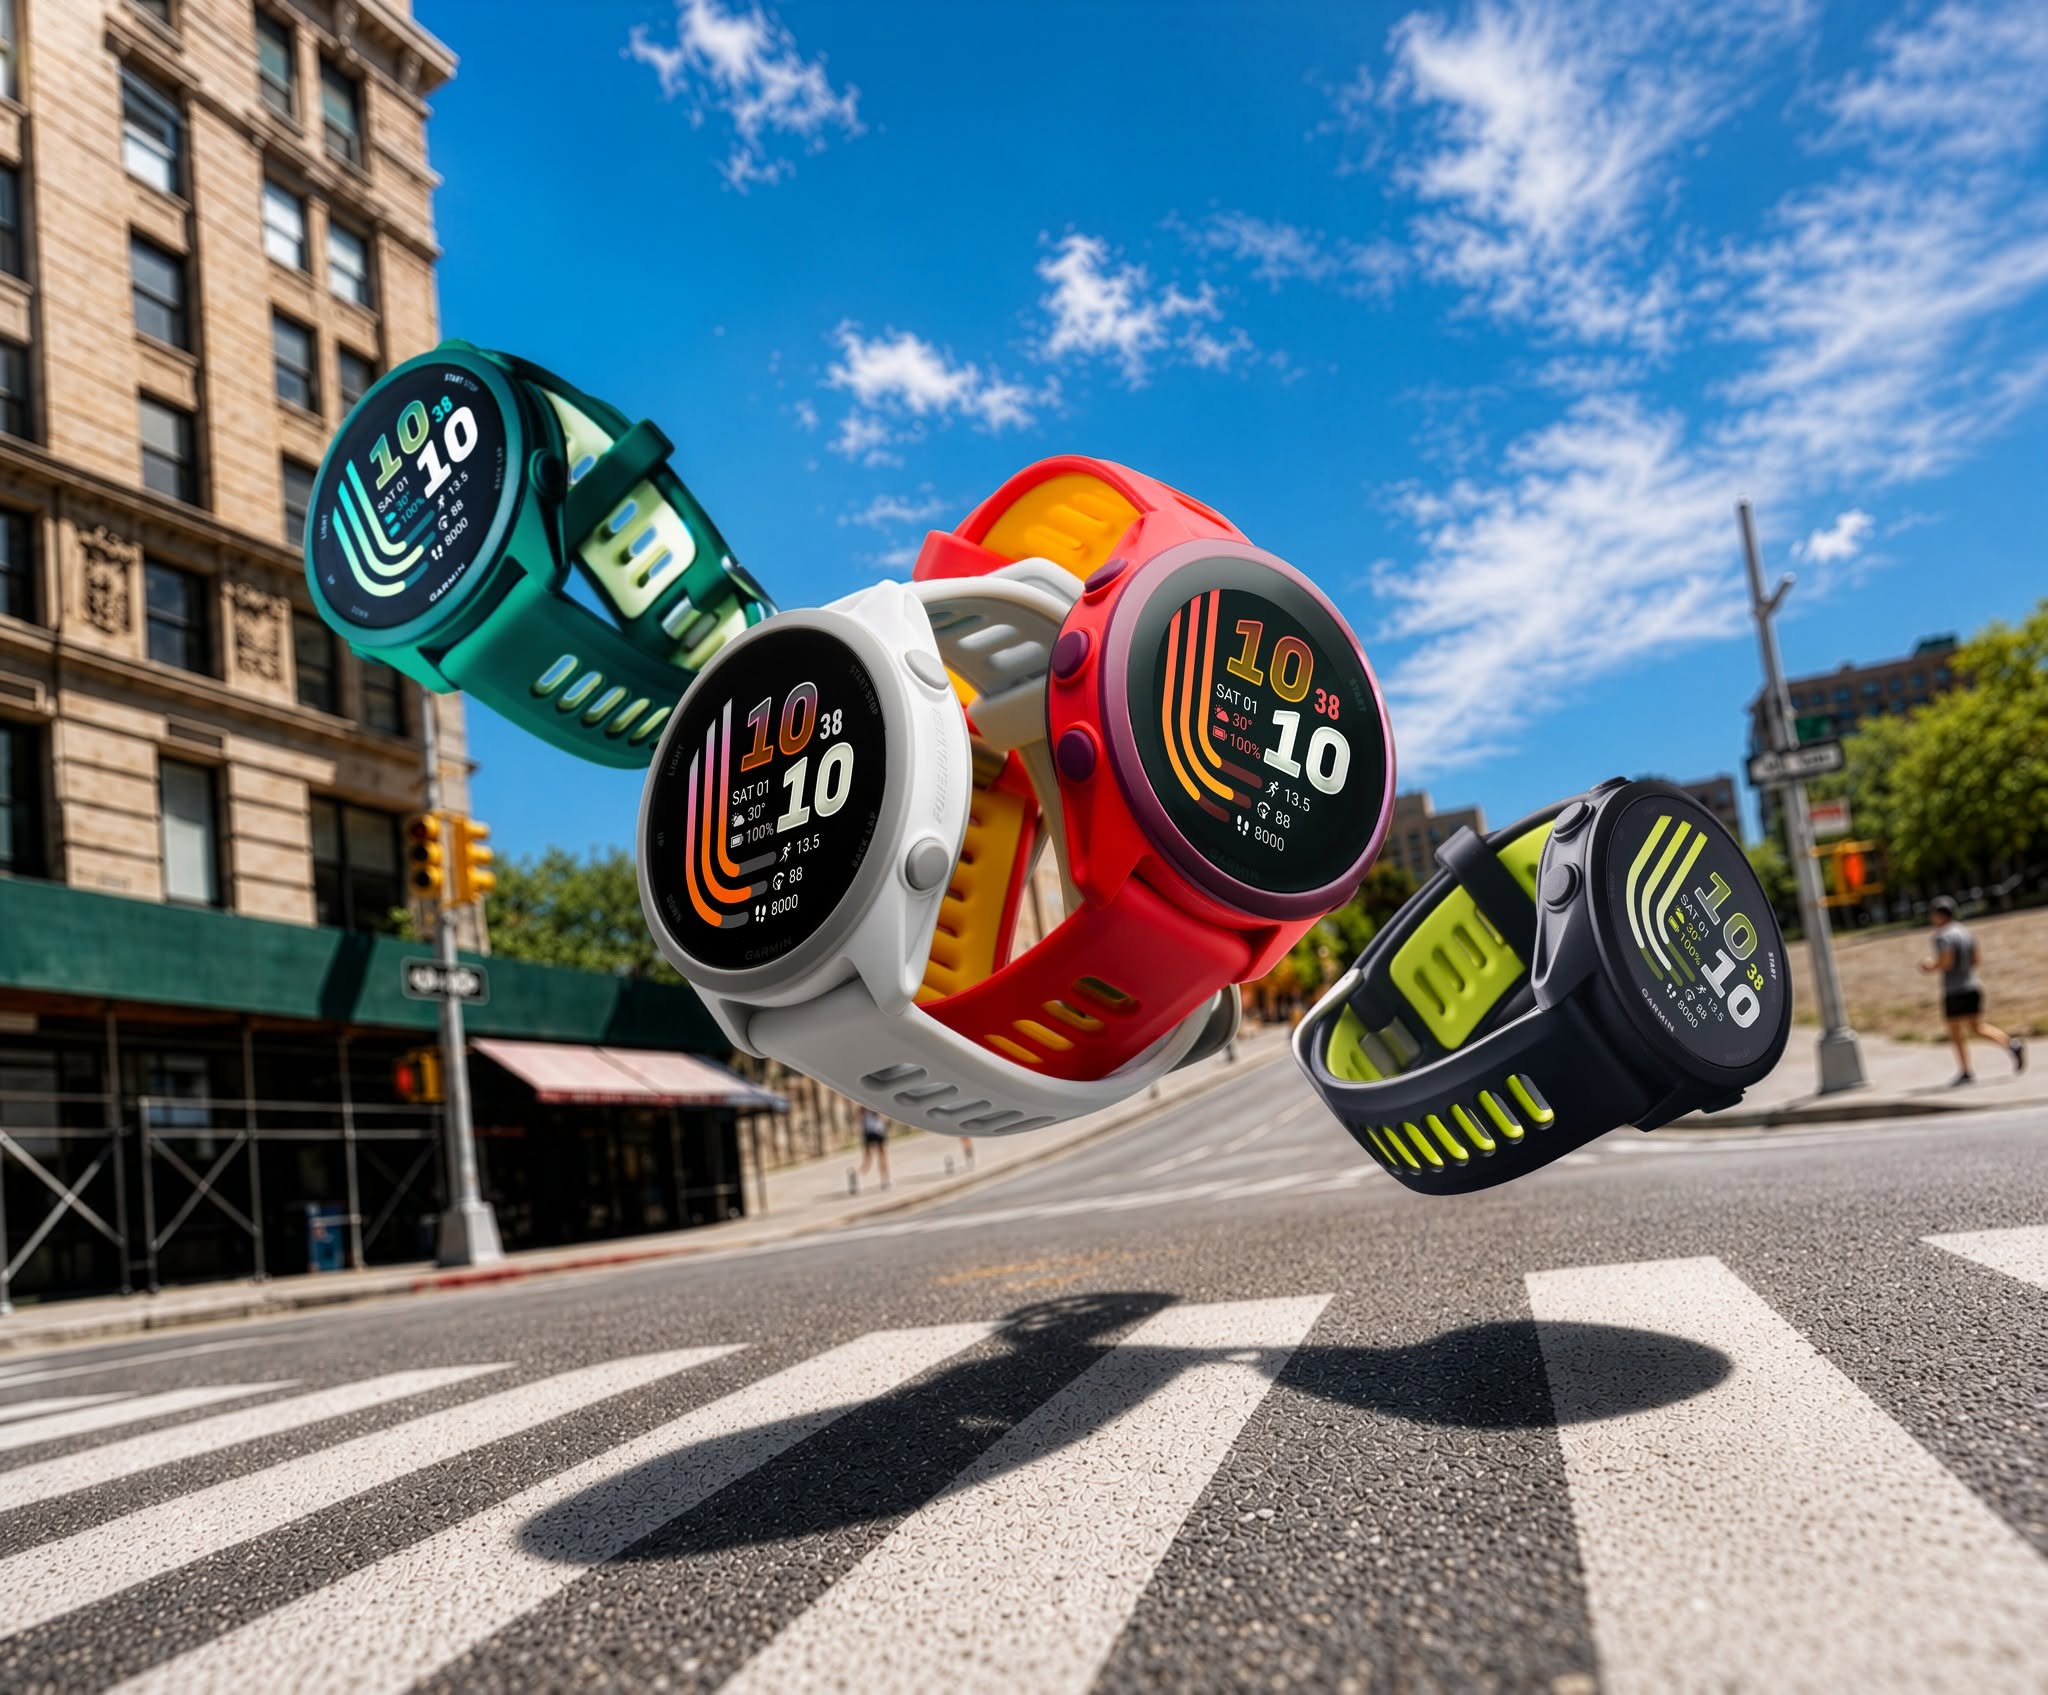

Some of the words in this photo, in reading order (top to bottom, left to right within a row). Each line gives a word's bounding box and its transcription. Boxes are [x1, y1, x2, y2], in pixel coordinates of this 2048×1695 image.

[444, 373, 464, 384] START
[369, 399, 430, 491] 10
[431, 395, 453, 423] 38
[416, 406, 479, 499] 10
[378, 488, 397, 513] SAT
[396, 476, 409, 492] 01
[449, 471, 469, 496] 13.5
[450, 499, 464, 518] 88
[444, 517, 468, 547] 8000
[429, 563, 466, 602] GARMIN
[1227, 619, 1314, 703] 10
[1313, 688, 1341, 721] 38
[1215, 683, 1241, 705] SAT
[1243, 695, 1258, 715] 01
[741, 681, 818, 773] 10
[819, 708, 843, 741] 38
[1231, 711, 1253, 732] 30°
[1229, 732, 1261, 760] 100%
[1264, 709, 1351, 797] 10
[667, 744, 685, 778] LIGHT
[732, 785, 756, 806] SAT
[756, 779, 769, 798] 01
[776, 742, 855, 833] 10
[1284, 788, 1311, 813] 13.5
[747, 802, 766, 822] 30°
[1274, 810, 1291, 829] 88
[746, 822, 774, 844] 100%
[796, 833, 821, 854] 13.5
[1254, 825, 1286, 852] 8000
[789, 866, 803, 884] 88
[771, 894, 799, 916] 8000
[1680, 894, 1700, 920] SAT
[1698, 921, 1710, 939] 01
[1694, 871, 1758, 961] 10
[1745, 962, 1764, 991] 38
[744, 936, 793, 962] GARMIN
[1680, 932, 1701, 966] 100%
[1767, 951, 1777, 981] START
[1700, 949, 1761, 1029] 10
[1641, 988, 1675, 1032] GARMIN
[1677, 1000, 1699, 1028] 8000
[1696, 1003, 1708, 1020] 88
[1708, 997, 1724, 1022] 13.5
